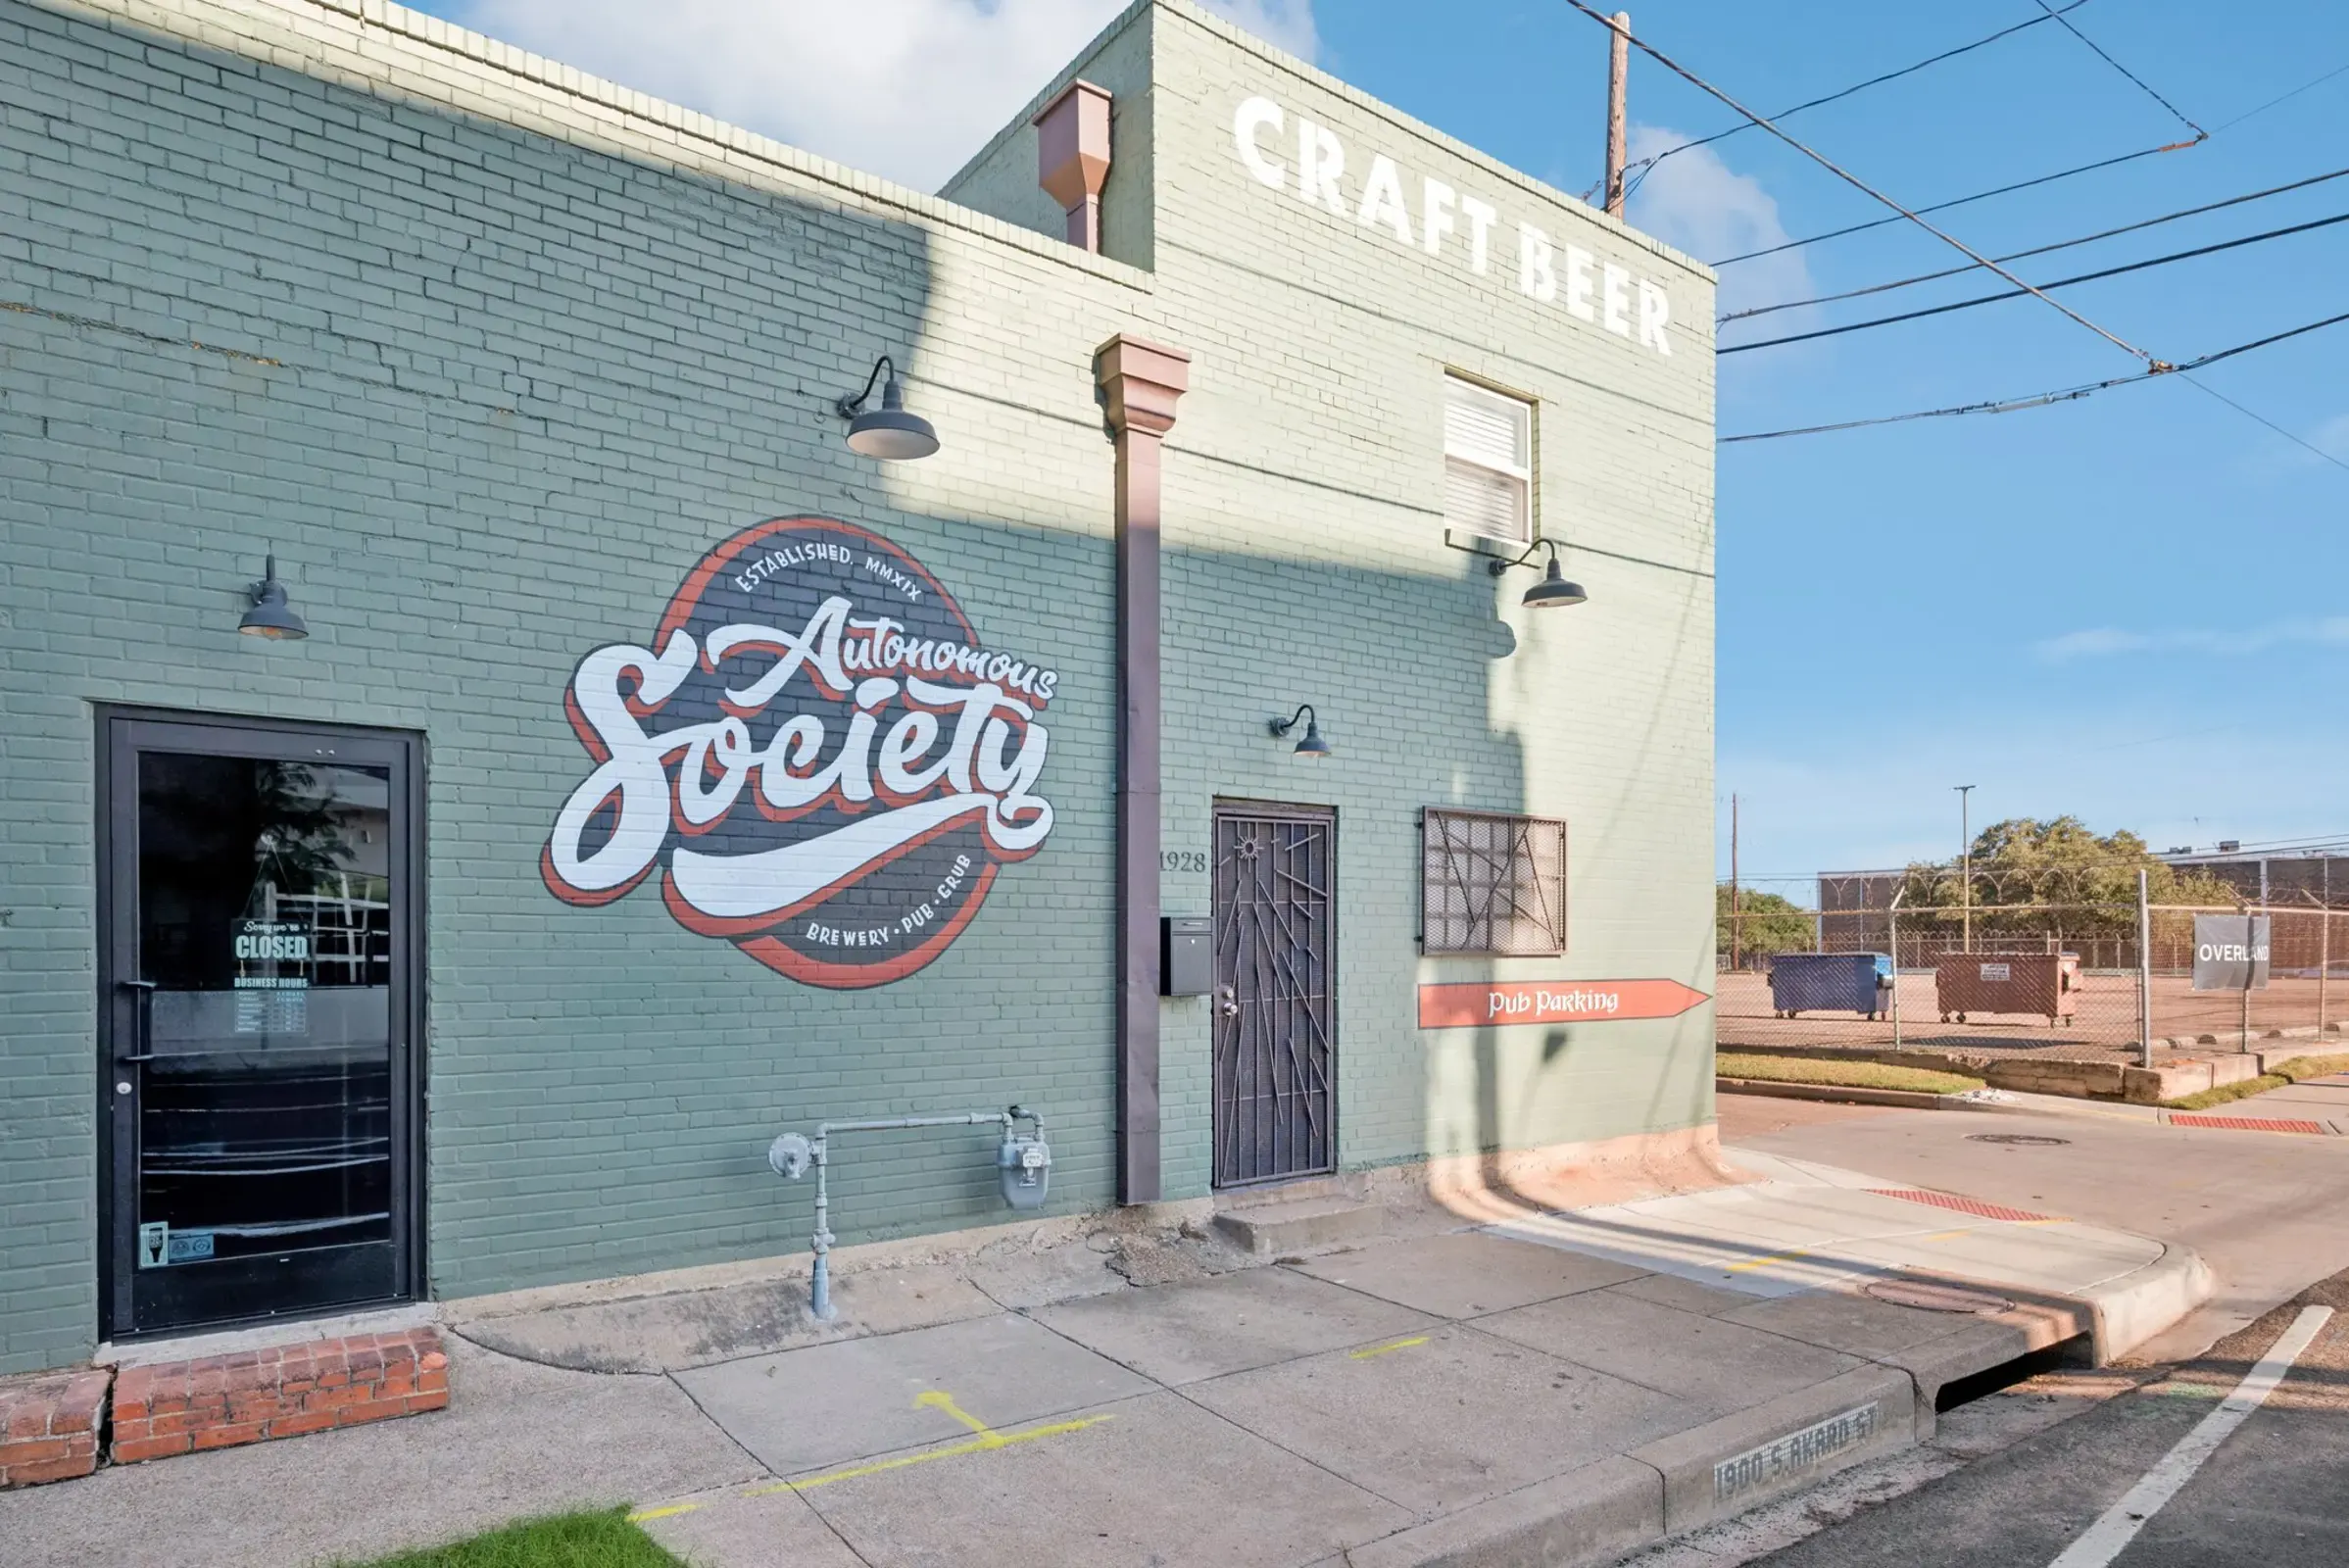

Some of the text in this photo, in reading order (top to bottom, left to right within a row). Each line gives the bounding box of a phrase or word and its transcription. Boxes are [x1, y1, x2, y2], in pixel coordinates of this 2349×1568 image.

[1233, 96, 1673, 357] CRAFT BEER
[865, 556, 921, 601] MMXIX
[706, 596, 1057, 708] Autonomous
[550, 627, 1054, 917] Society
[1159, 851, 1206, 872] 1928
[806, 854, 971, 947] BREWERY PUB GRUB
[235, 935, 309, 958] CLOSED
[234, 977, 309, 988] BUSINESS HOURS
[1488, 990, 1619, 1018] Pub Parking
